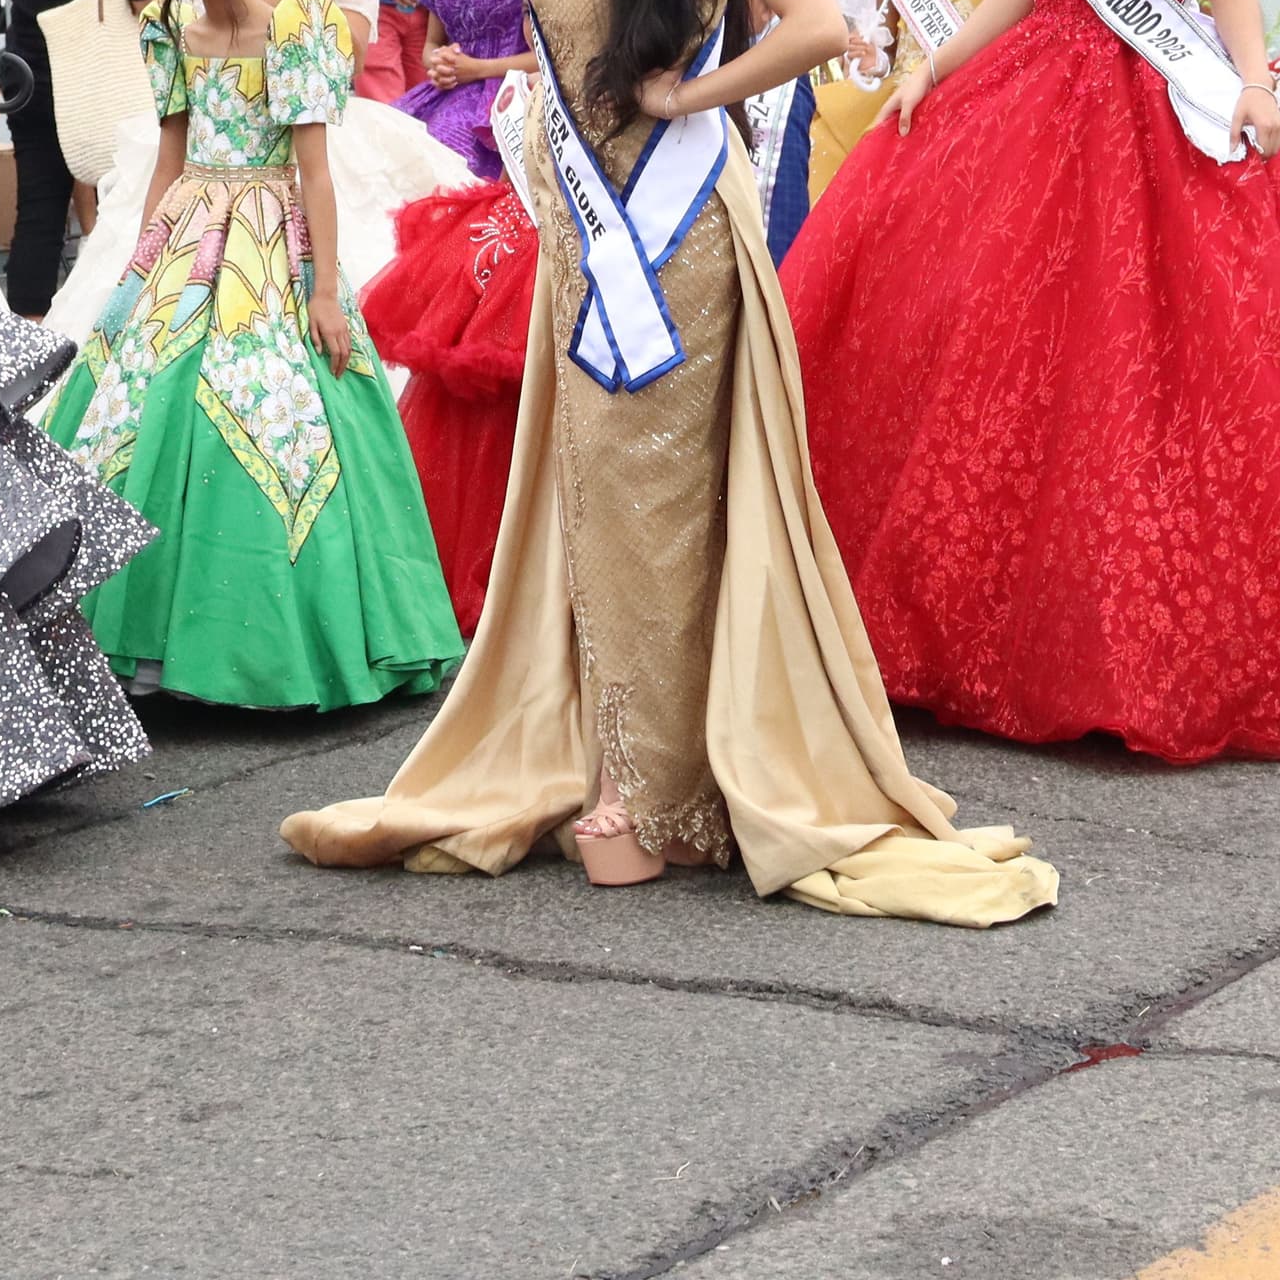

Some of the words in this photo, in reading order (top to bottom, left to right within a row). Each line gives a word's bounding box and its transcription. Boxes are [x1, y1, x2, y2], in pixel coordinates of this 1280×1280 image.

[920, 13, 941, 38] THE
[1147, 28, 1194, 62] 2025
[565, 165, 606, 242] GLOBE
